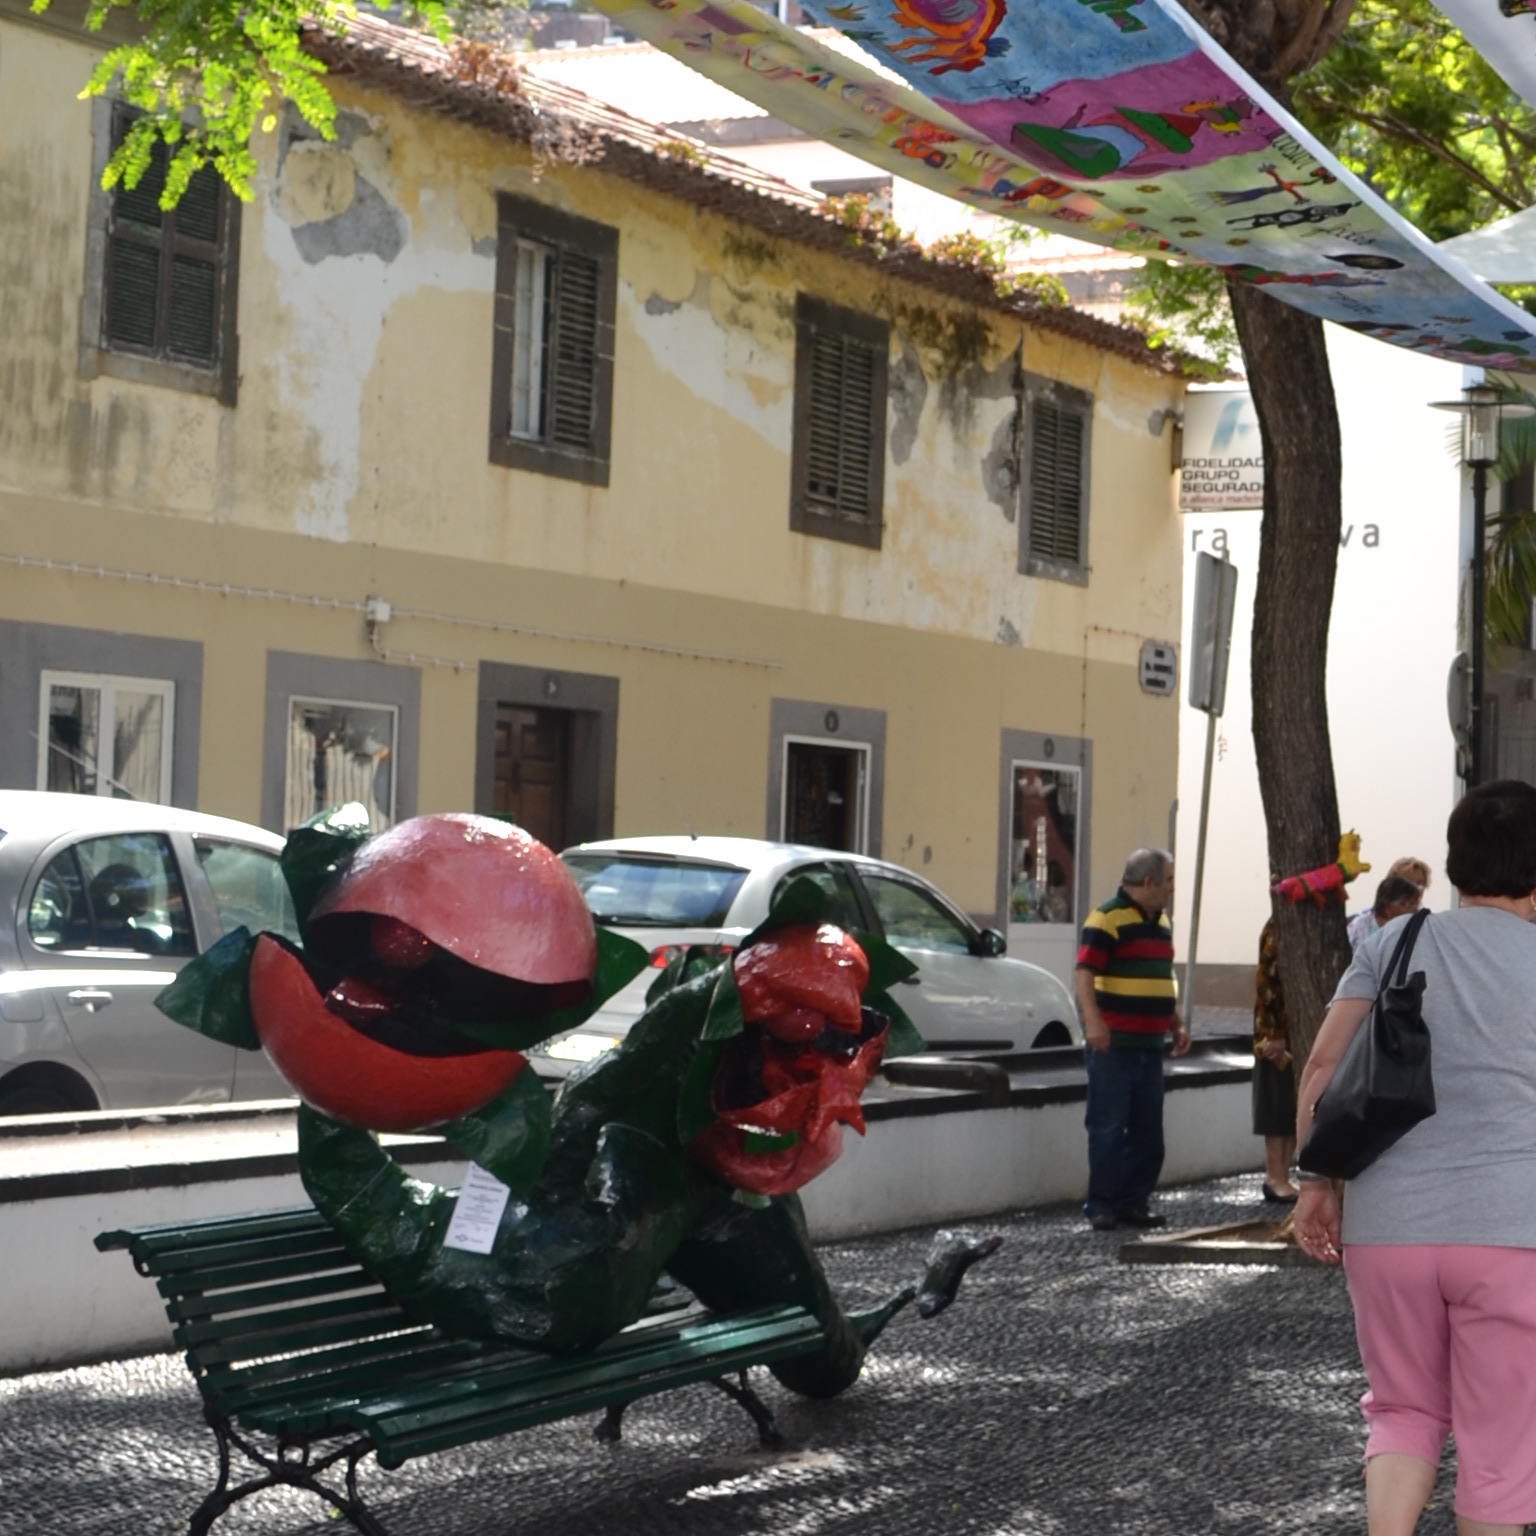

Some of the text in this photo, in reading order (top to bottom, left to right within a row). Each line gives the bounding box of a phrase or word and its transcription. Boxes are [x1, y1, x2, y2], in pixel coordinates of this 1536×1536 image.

[1183, 458, 1264, 468] FIDELIDAD
[1182, 470, 1240, 481] GRUPO
[1182, 482, 1264, 494] SEGURAD
